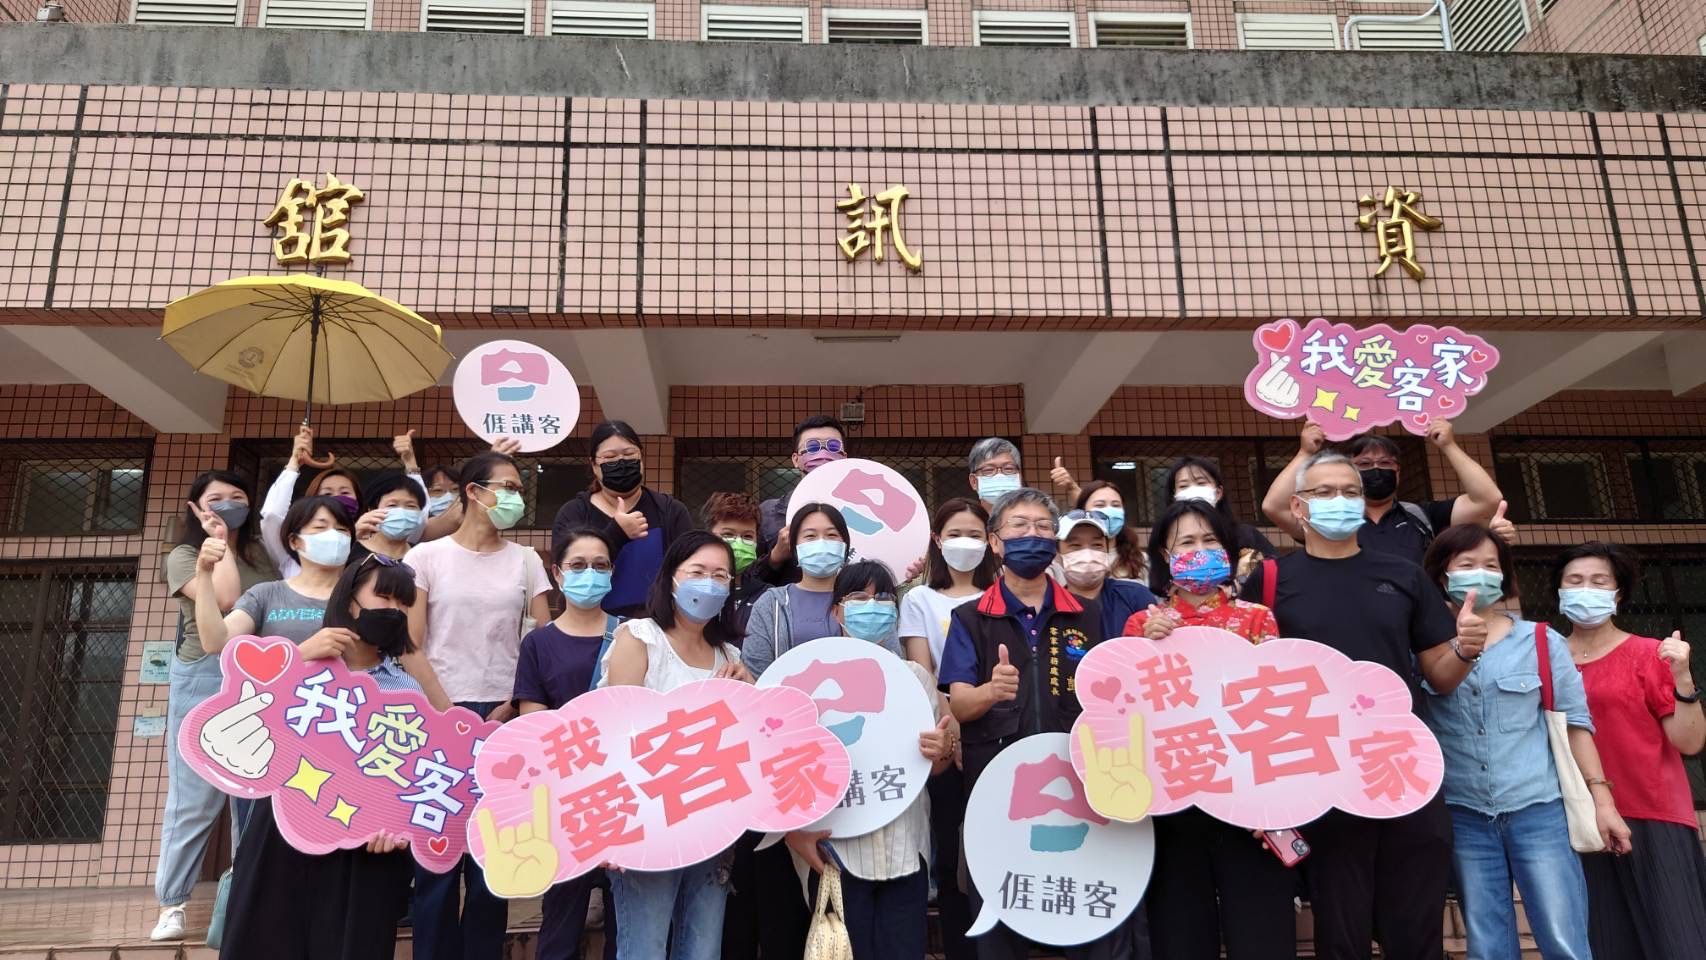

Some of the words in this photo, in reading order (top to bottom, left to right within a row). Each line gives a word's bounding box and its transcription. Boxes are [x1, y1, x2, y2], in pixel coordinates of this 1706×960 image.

[837, 183, 921, 274] 訊
[1355, 185, 1443, 282] 資
[1300, 329, 1476, 412] 我愛客家
[1135, 652, 1431, 801] 我愛客家
[539, 699, 842, 864] 我愛客家
